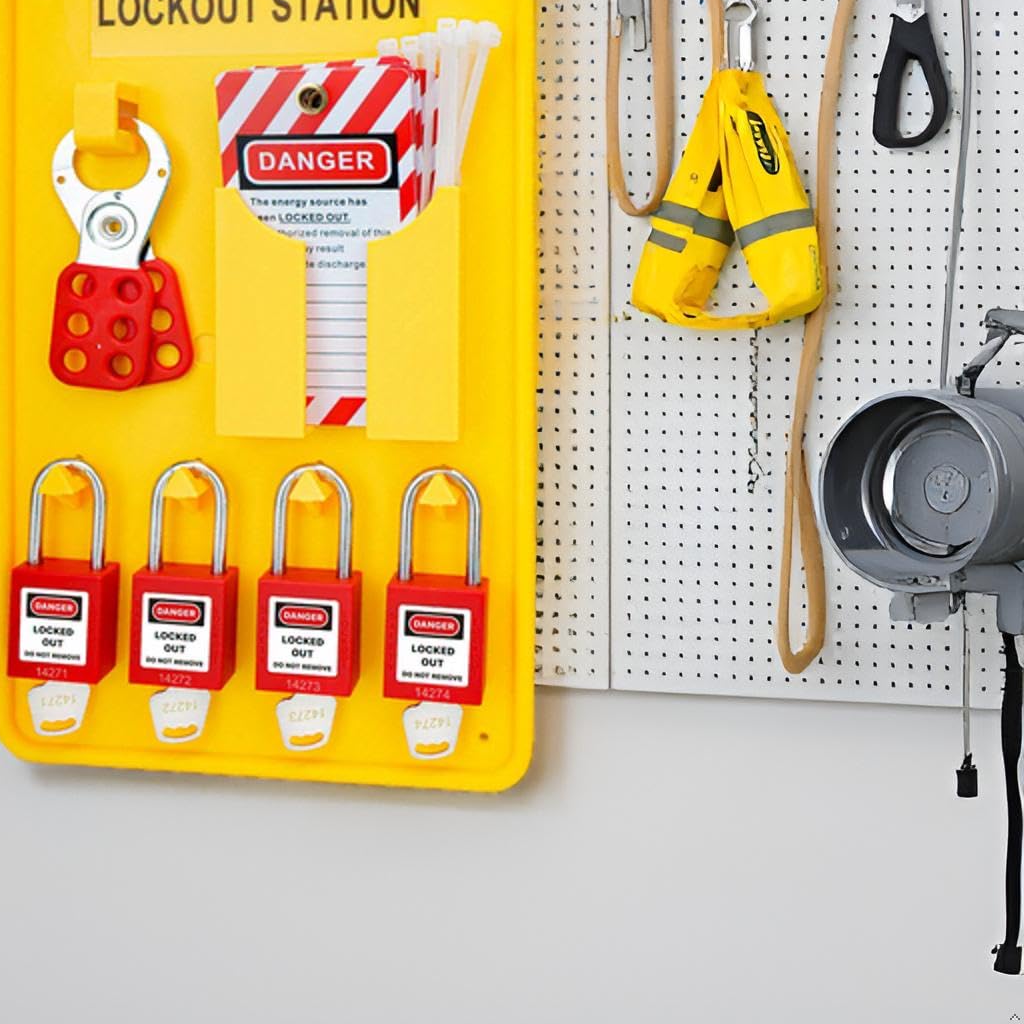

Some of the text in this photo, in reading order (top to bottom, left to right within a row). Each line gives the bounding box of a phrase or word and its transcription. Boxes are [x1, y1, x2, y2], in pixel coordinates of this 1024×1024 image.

[258, 150, 375, 171] DANGER
[250, 197, 368, 208] The energy source has
[257, 214, 276, 222] een
[278, 213, 325, 223] LOCKED
[320, 229, 360, 237] removal
[362, 229, 371, 237] of
[316, 245, 345, 253] result
[317, 260, 366, 270] discharge
[35, 600, 74, 613] DANGER
[157, 606, 197, 617] DANGER
[283, 610, 325, 622] DANGER
[33, 625, 75, 637] LOCKED
[413, 619, 455, 631] DANGER
[41, 637, 64, 648] OUT
[154, 631, 197, 643] LOCKED
[281, 635, 325, 647] LOCKED
[163, 643, 186, 654] OUT
[291, 648, 314, 659] OUT
[411, 644, 456, 656] LOCKED
[421, 657, 445, 668] OUT
[36, 666, 68, 678] 14271
[159, 673, 192, 686] 14272
[286, 679, 321, 692] 14273
[416, 687, 451, 700] 14274
